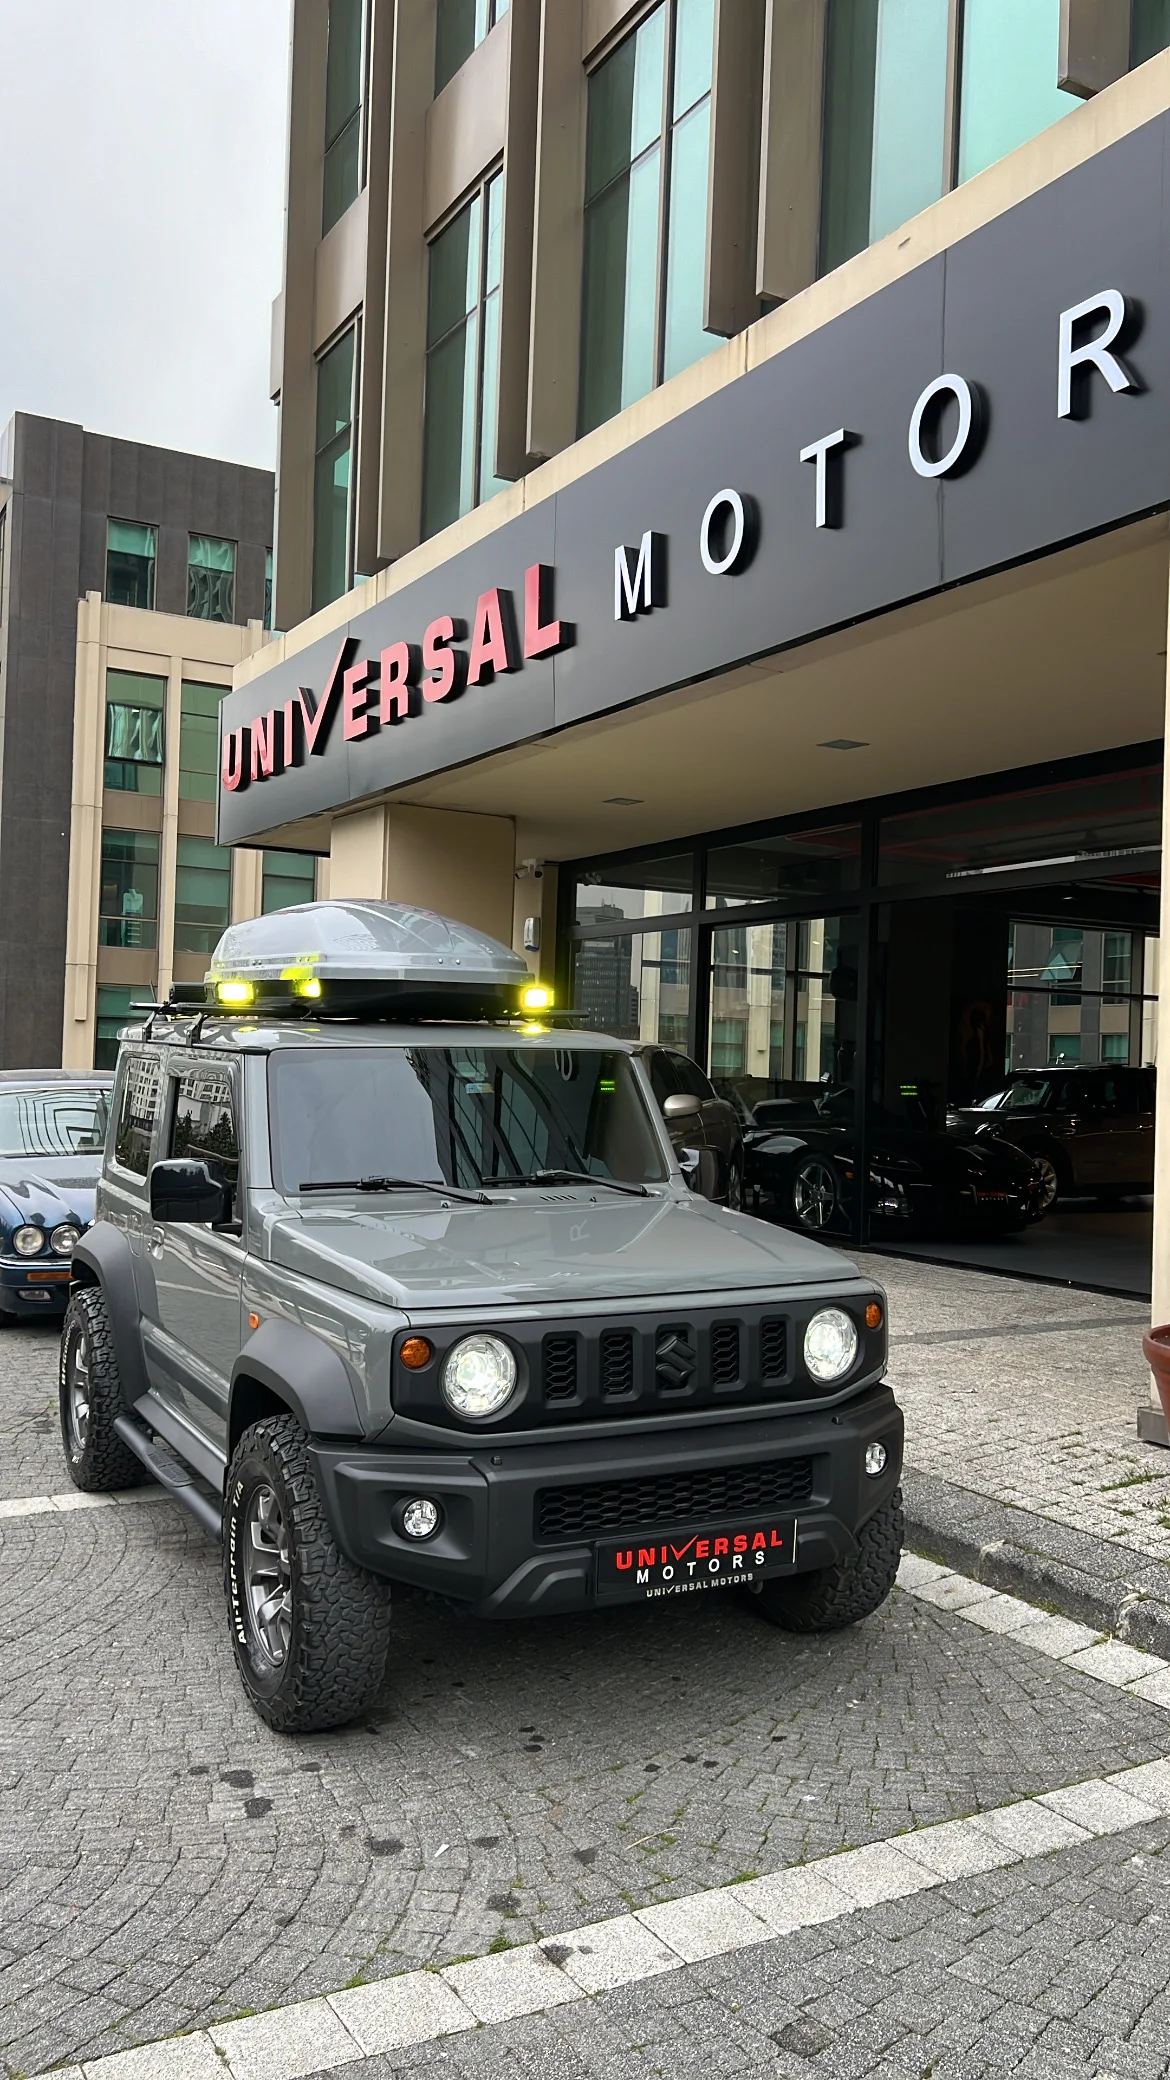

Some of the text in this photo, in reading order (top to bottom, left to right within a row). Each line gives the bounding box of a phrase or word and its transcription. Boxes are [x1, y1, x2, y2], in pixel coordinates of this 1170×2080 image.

[222, 288, 1138, 792] UNIVERSAL MOTOR
[230, 1480, 247, 1644] All-Terrain T/A
[615, 1530, 783, 1570] UNIVERSAL
[636, 1551, 765, 1584] MOTORS
[646, 1573, 754, 1598] UNIVERSAL MOTORS
